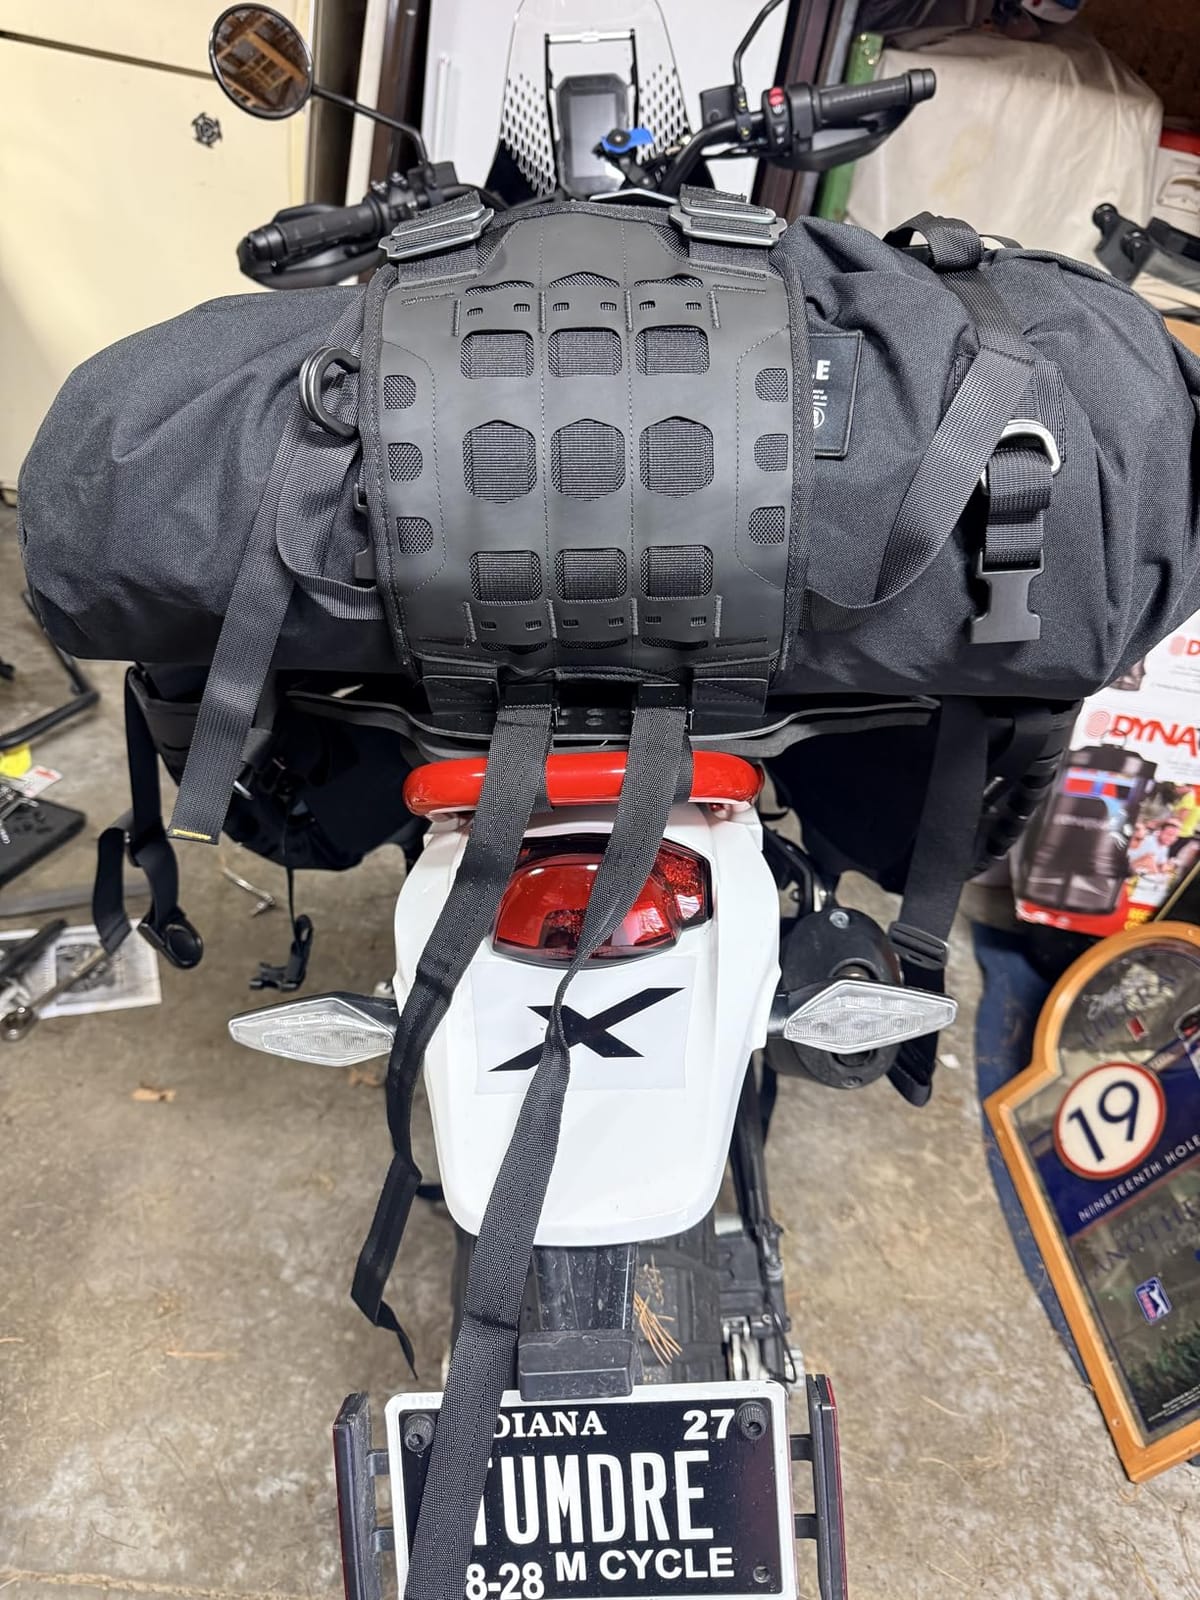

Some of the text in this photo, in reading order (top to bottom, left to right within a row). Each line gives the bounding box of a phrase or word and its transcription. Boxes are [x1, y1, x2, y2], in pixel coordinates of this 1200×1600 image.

[1110, 715, 1200, 758] DYNA
[1066, 1079, 1140, 1162] 19
[1078, 1134, 1200, 1223] NINETEENTH HOLE
[494, 1409, 736, 1440] DIANA 27
[554, 1547, 735, 1582] M CYCLE
